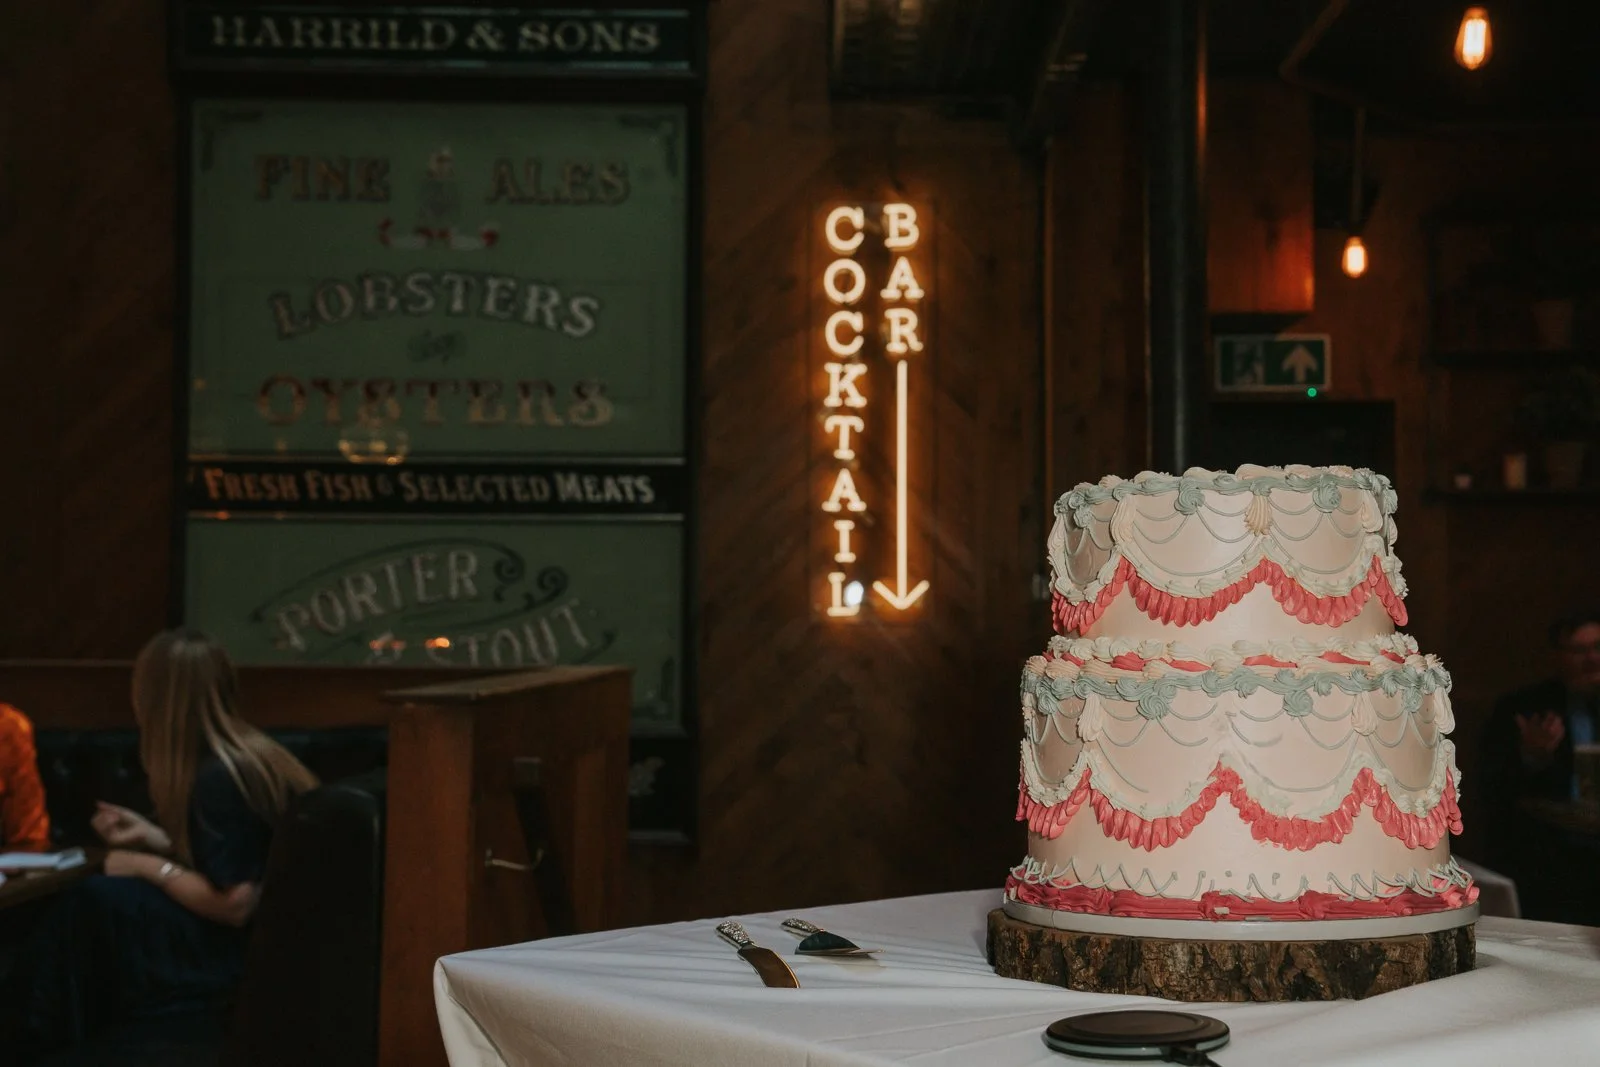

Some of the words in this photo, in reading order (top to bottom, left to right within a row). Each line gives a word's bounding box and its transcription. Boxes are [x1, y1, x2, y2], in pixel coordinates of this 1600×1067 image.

[211, 14, 456, 51] HARRILD
[466, 18, 507, 52] &
[517, 18, 661, 53] SONS
[486, 157, 631, 206] ALES
[269, 270, 600, 339] LOBSTERS
[880, 203, 925, 354] BAR
[255, 373, 615, 428] OYSTERS
[822, 205, 868, 618] COCKTAIL
[203, 466, 300, 501] FRESH
[303, 468, 375, 501] FISH
[397, 470, 550, 503] SELECTED
[552, 471, 655, 504] MEATS
[273, 549, 478, 652] PORTER
